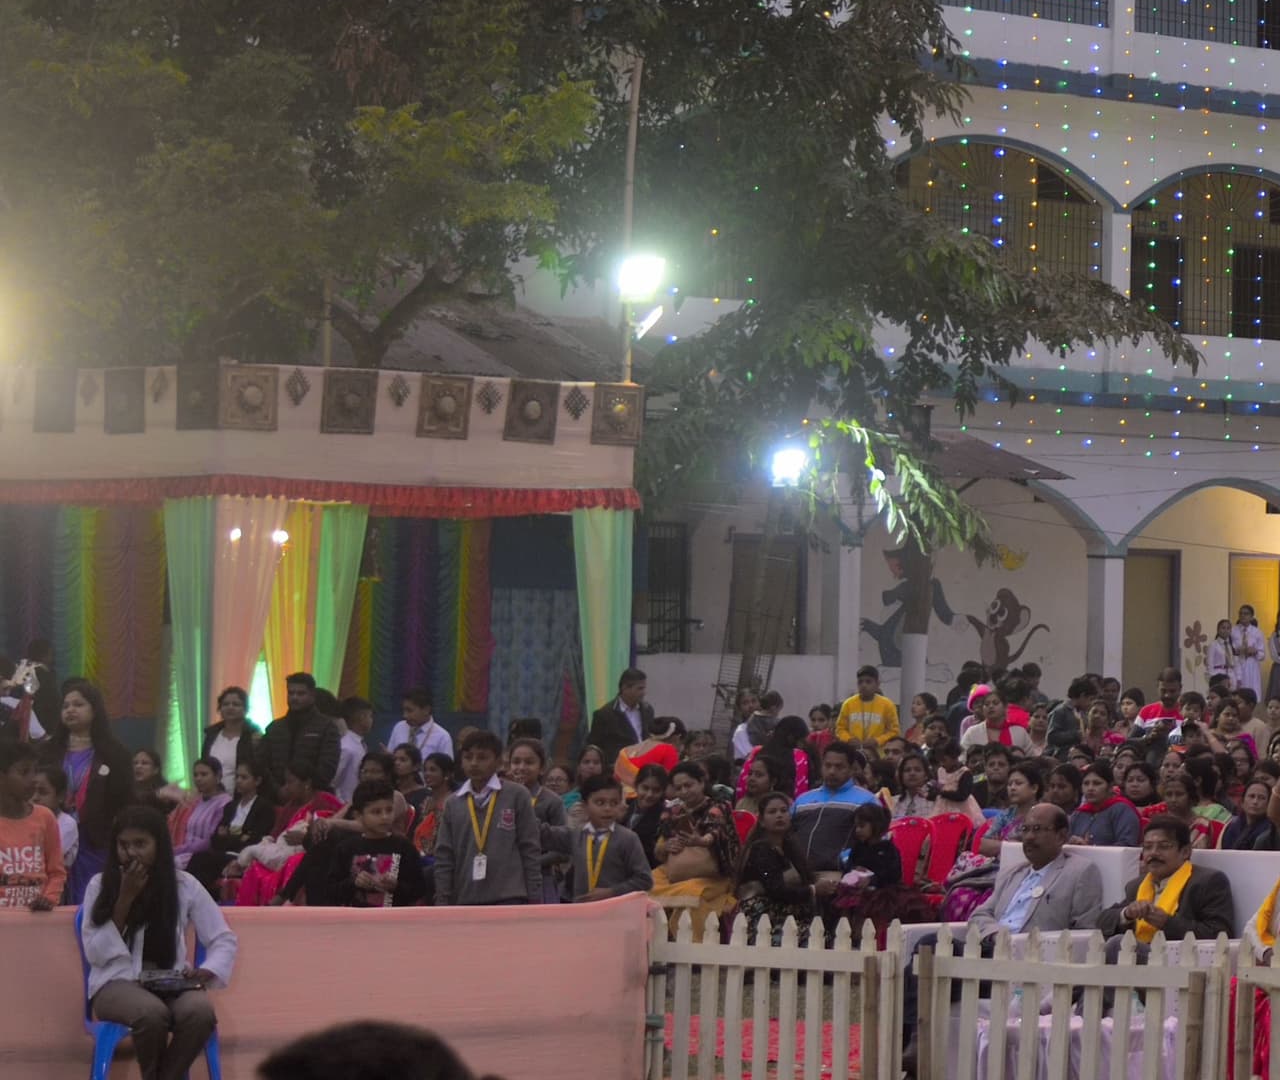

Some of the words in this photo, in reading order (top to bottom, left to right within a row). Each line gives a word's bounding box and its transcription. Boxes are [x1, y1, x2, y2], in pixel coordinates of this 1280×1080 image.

[0, 846, 42, 864] NICE
[3, 861, 42, 874] GUYS
[5, 886, 41, 897] FINISH
